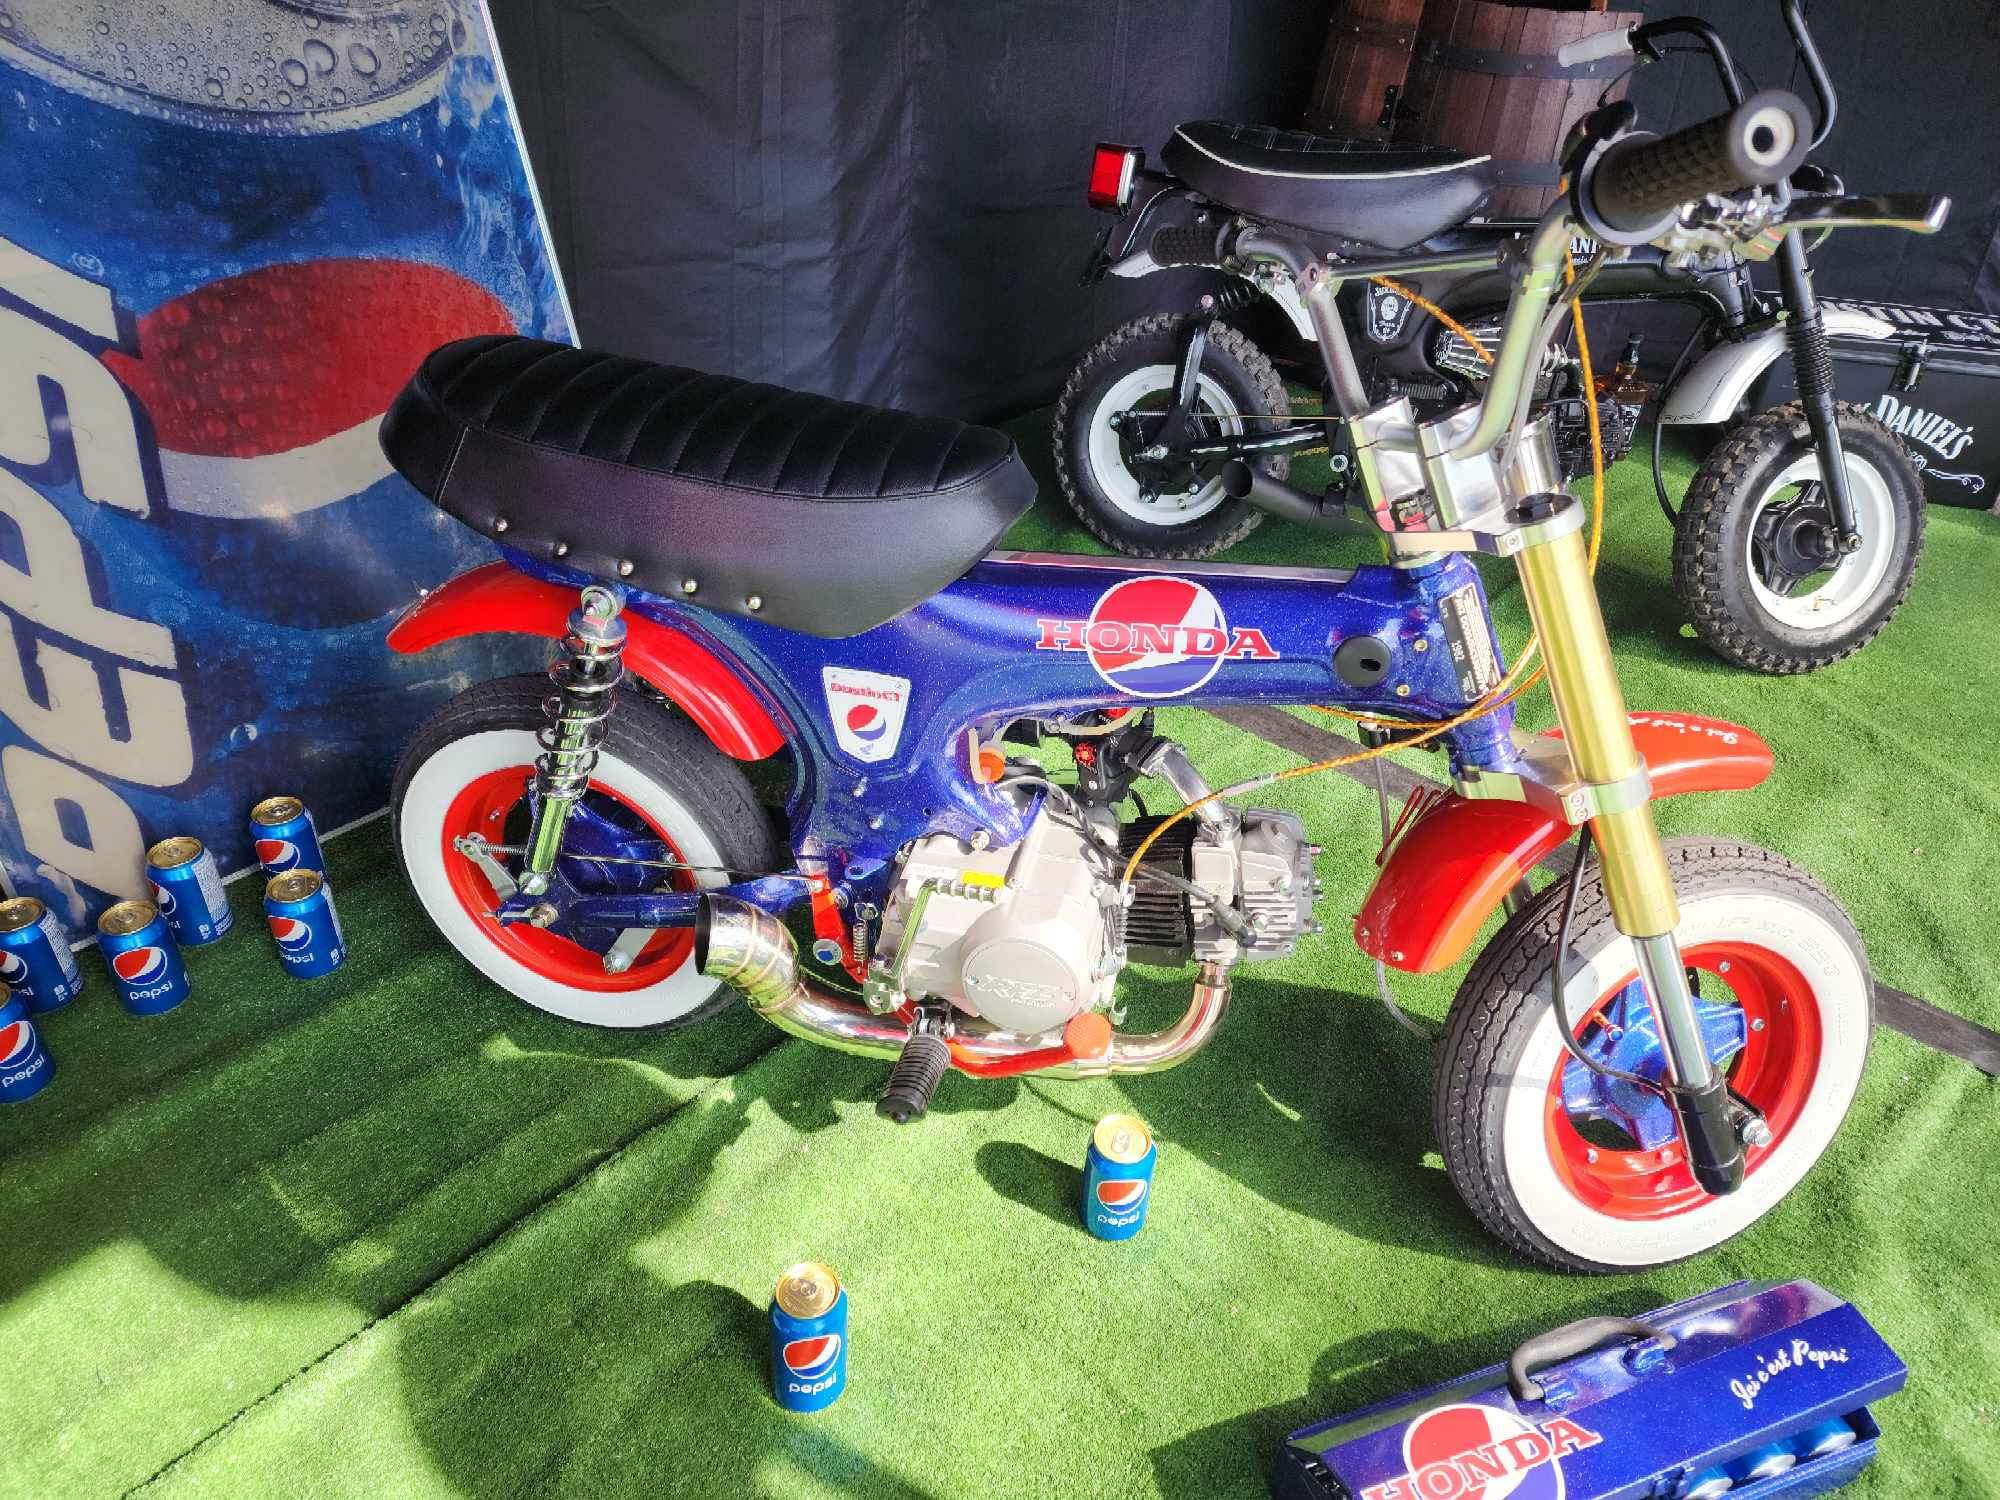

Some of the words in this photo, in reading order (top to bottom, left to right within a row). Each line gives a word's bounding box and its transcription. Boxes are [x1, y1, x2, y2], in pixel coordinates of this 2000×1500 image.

[1036, 618, 1281, 660] HONDA
[128, 981, 174, 1001] pepsi
[2, 1053, 46, 1088] pepsi
[1096, 1210, 1141, 1228] pepsi
[1790, 1338, 1850, 1370] Pepsi
[788, 1371, 838, 1397] pepsi
